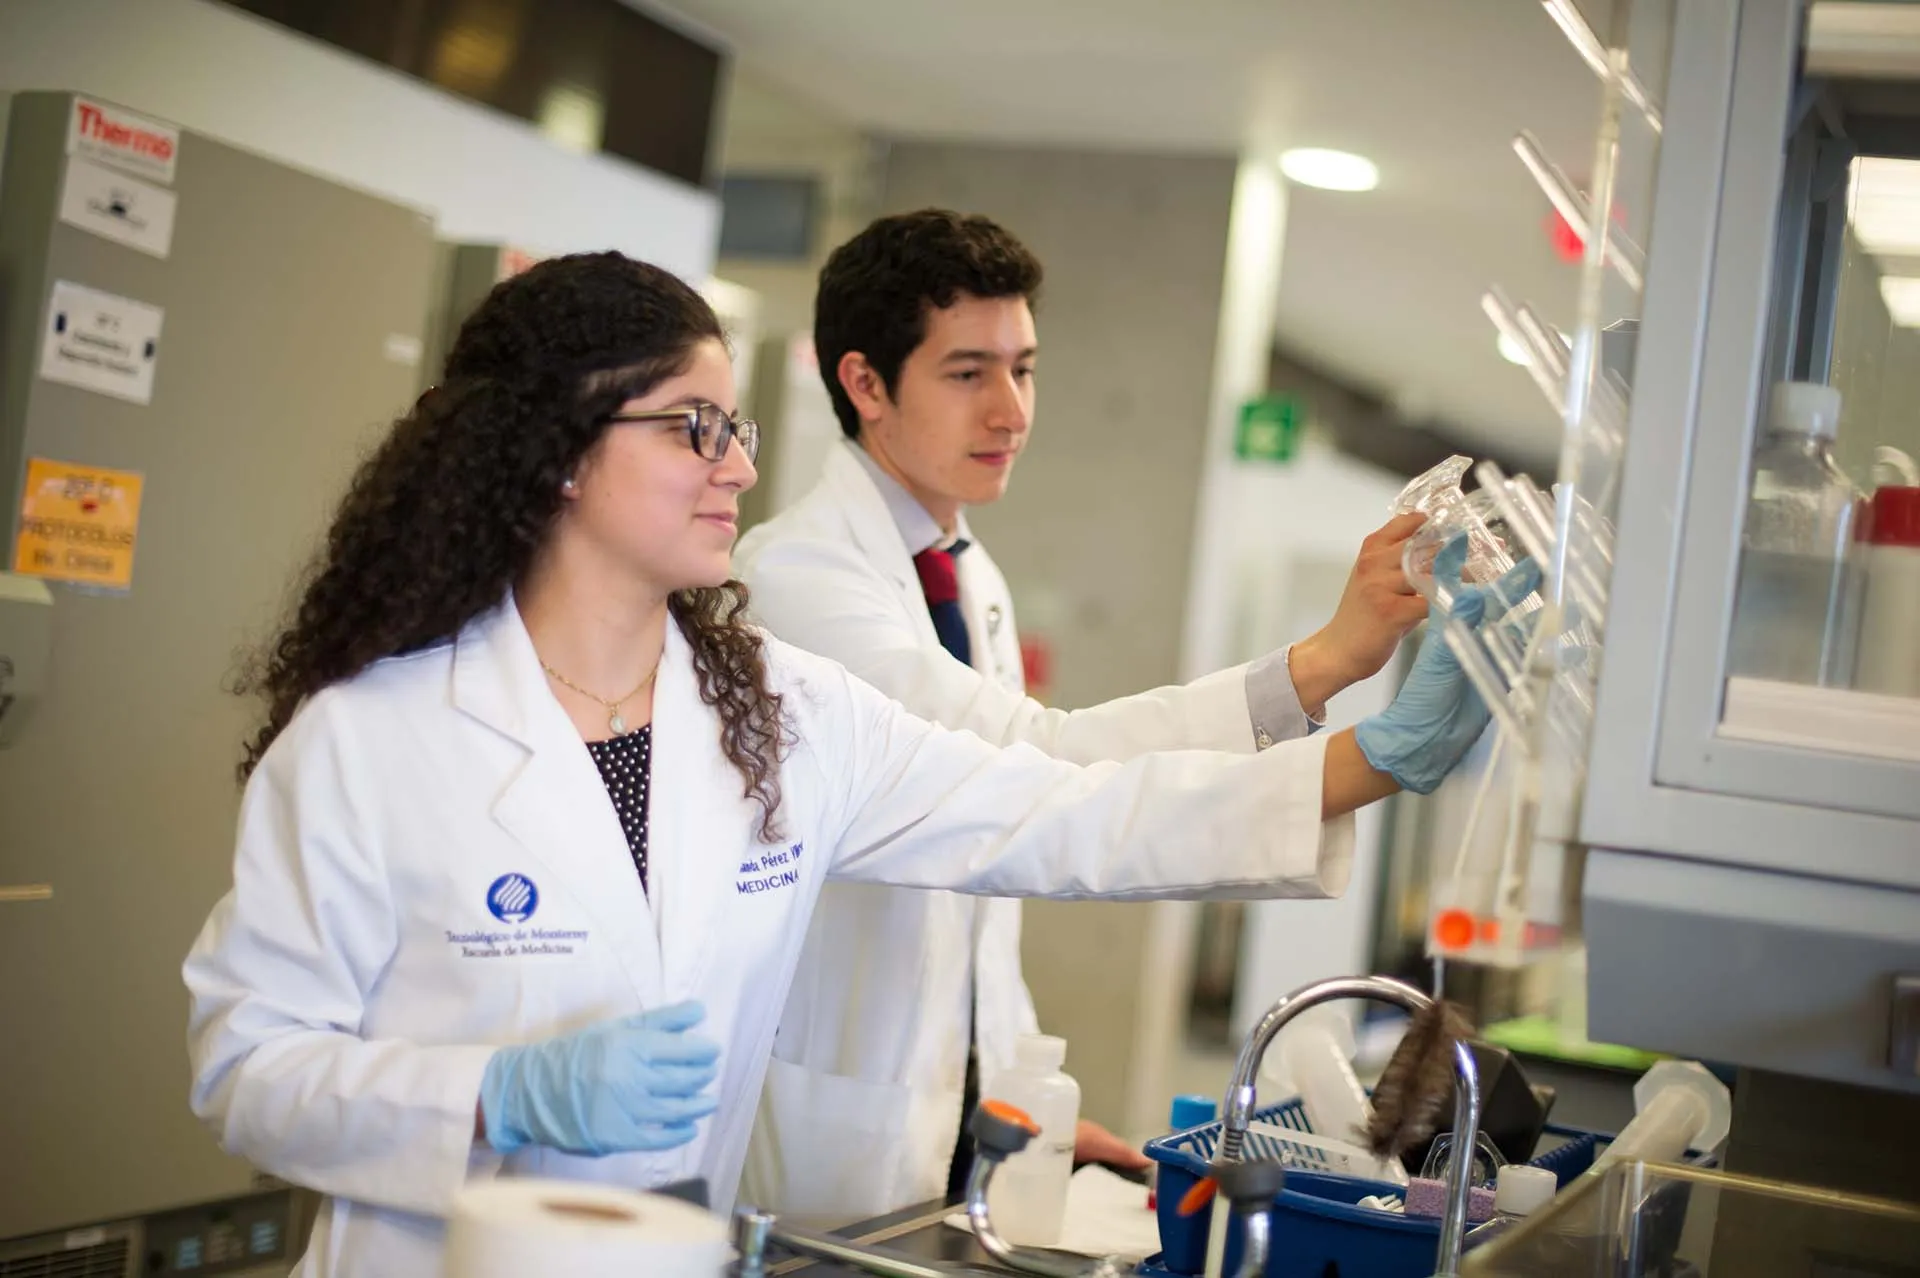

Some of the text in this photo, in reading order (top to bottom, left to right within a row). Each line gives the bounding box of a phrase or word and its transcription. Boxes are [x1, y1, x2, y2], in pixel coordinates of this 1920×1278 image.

[77, 102, 174, 162] Thermo
[760, 851, 789, 870] Pérez
[445, 928, 588, 945] Tecnológico de Monterrey
[461, 943, 574, 958] Escuela de Medicina
